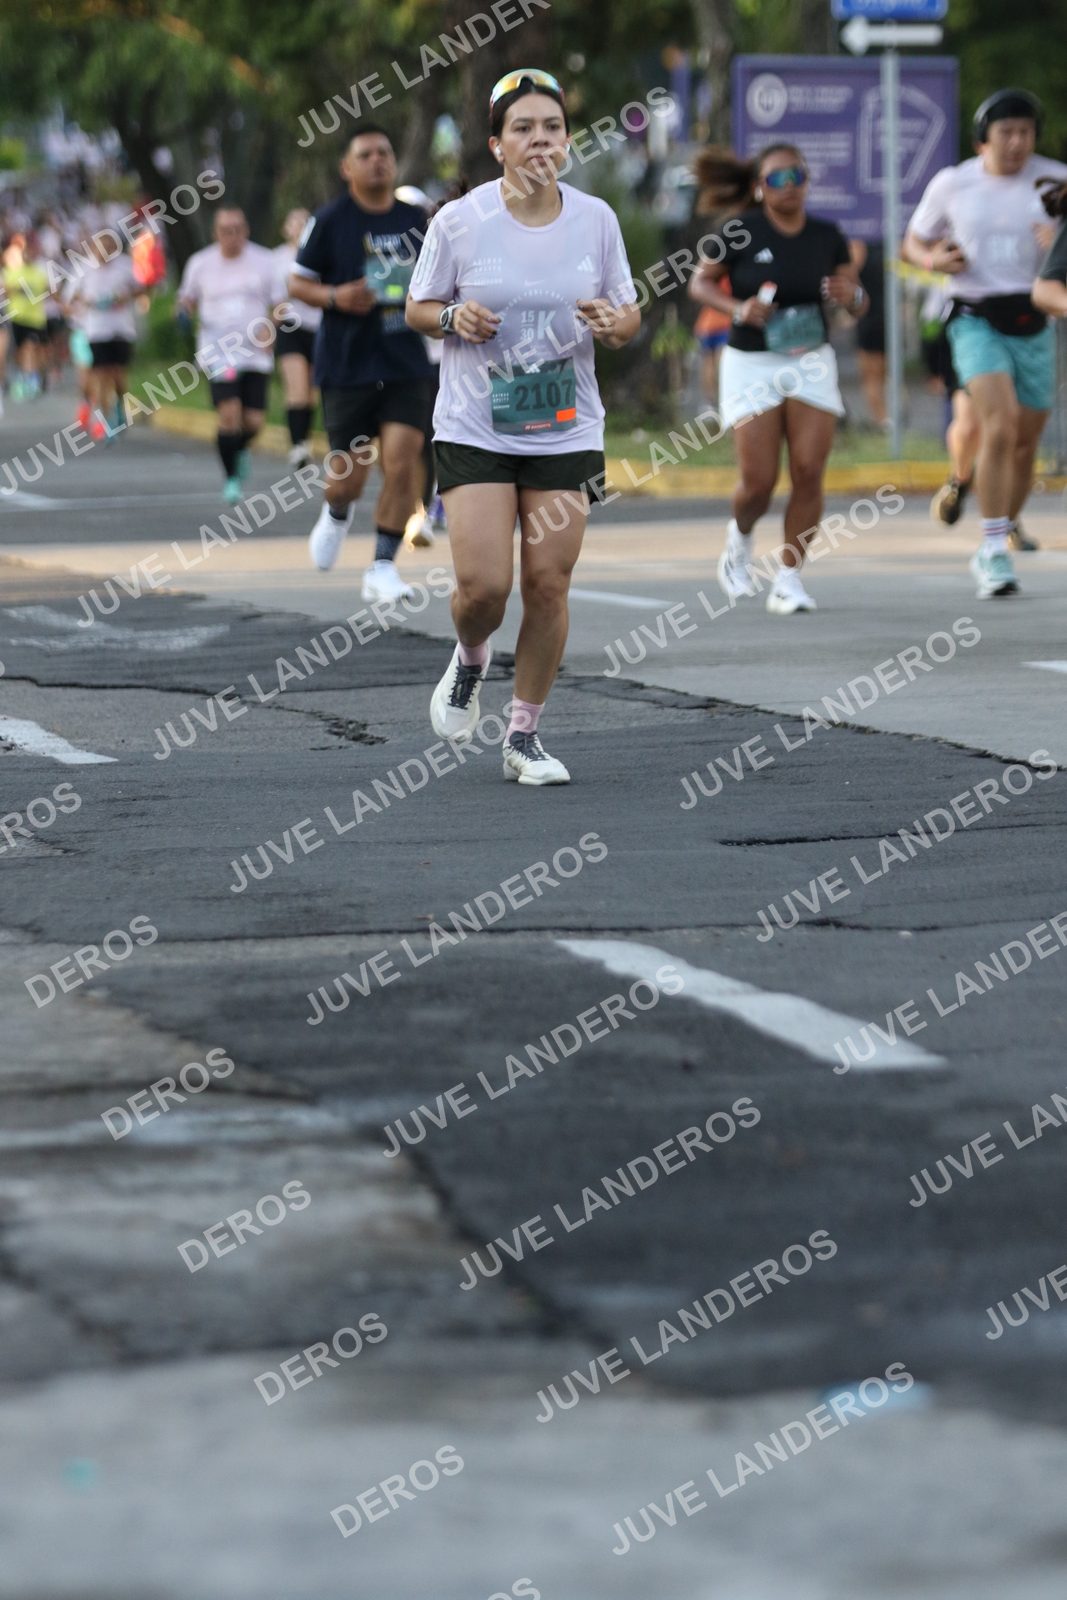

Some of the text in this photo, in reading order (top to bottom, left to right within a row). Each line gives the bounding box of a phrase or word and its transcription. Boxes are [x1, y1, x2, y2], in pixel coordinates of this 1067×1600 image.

[521, 311, 557, 339] 15 K
[521, 328, 535, 339] 30
[514, 379, 573, 411] 2107
